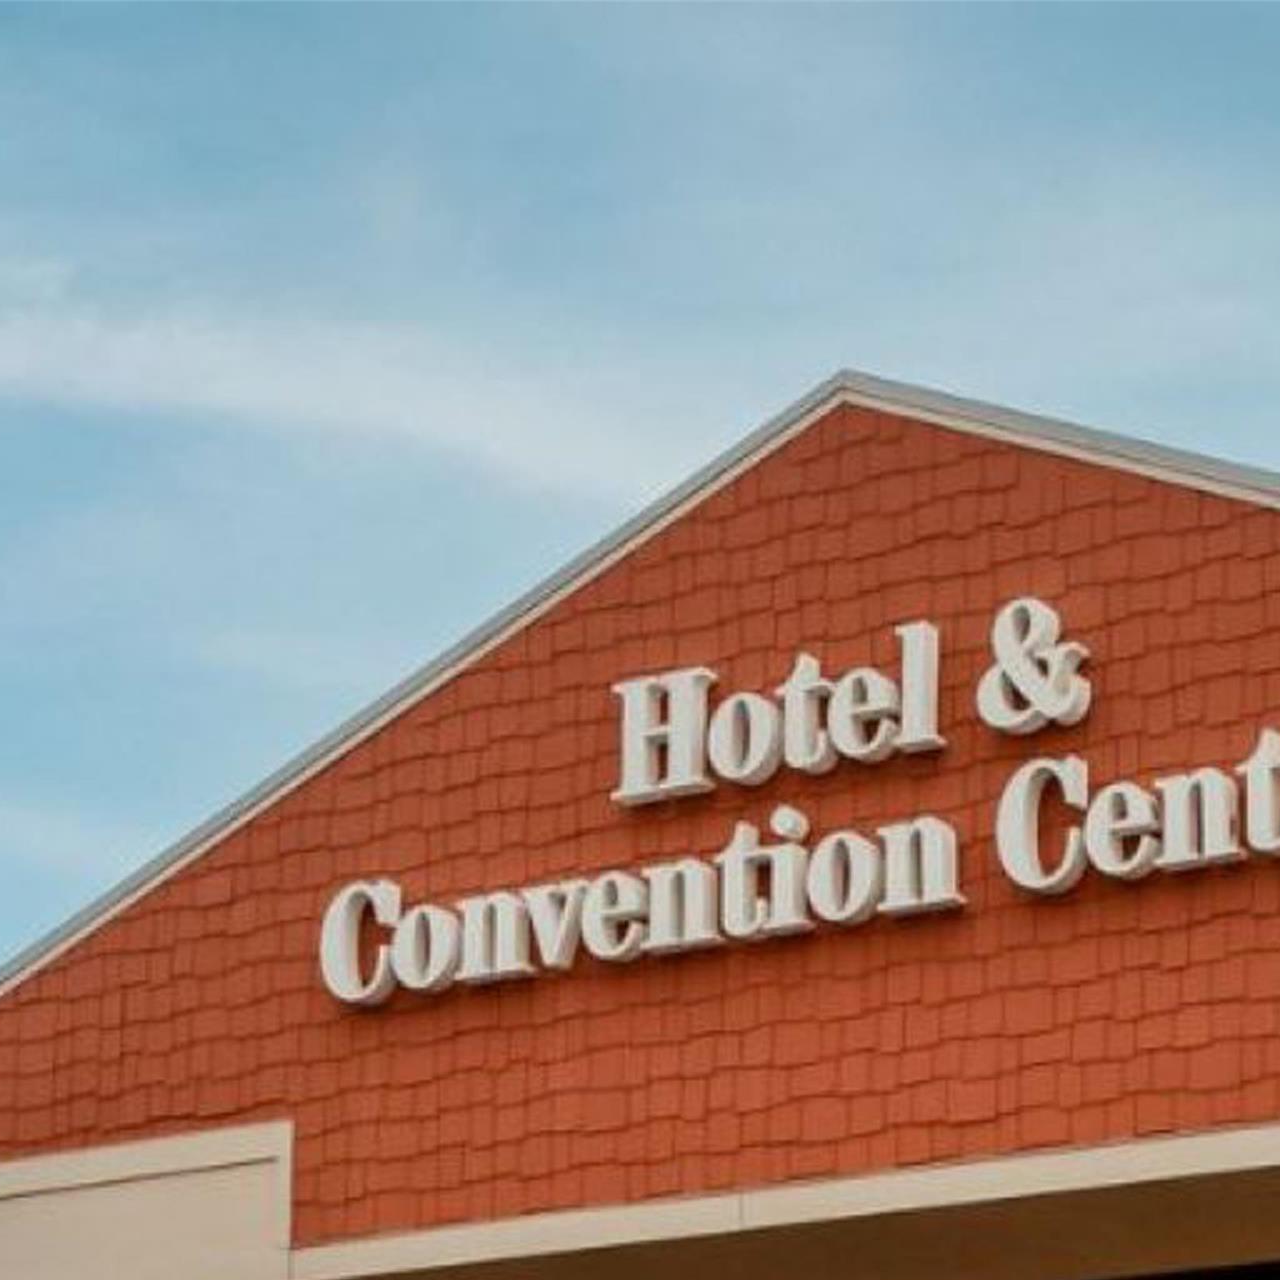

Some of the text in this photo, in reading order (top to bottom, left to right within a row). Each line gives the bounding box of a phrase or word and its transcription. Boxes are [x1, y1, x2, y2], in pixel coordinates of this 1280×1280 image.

[611, 595, 1093, 805] Hotel &
[320, 806, 966, 1007] Convention
